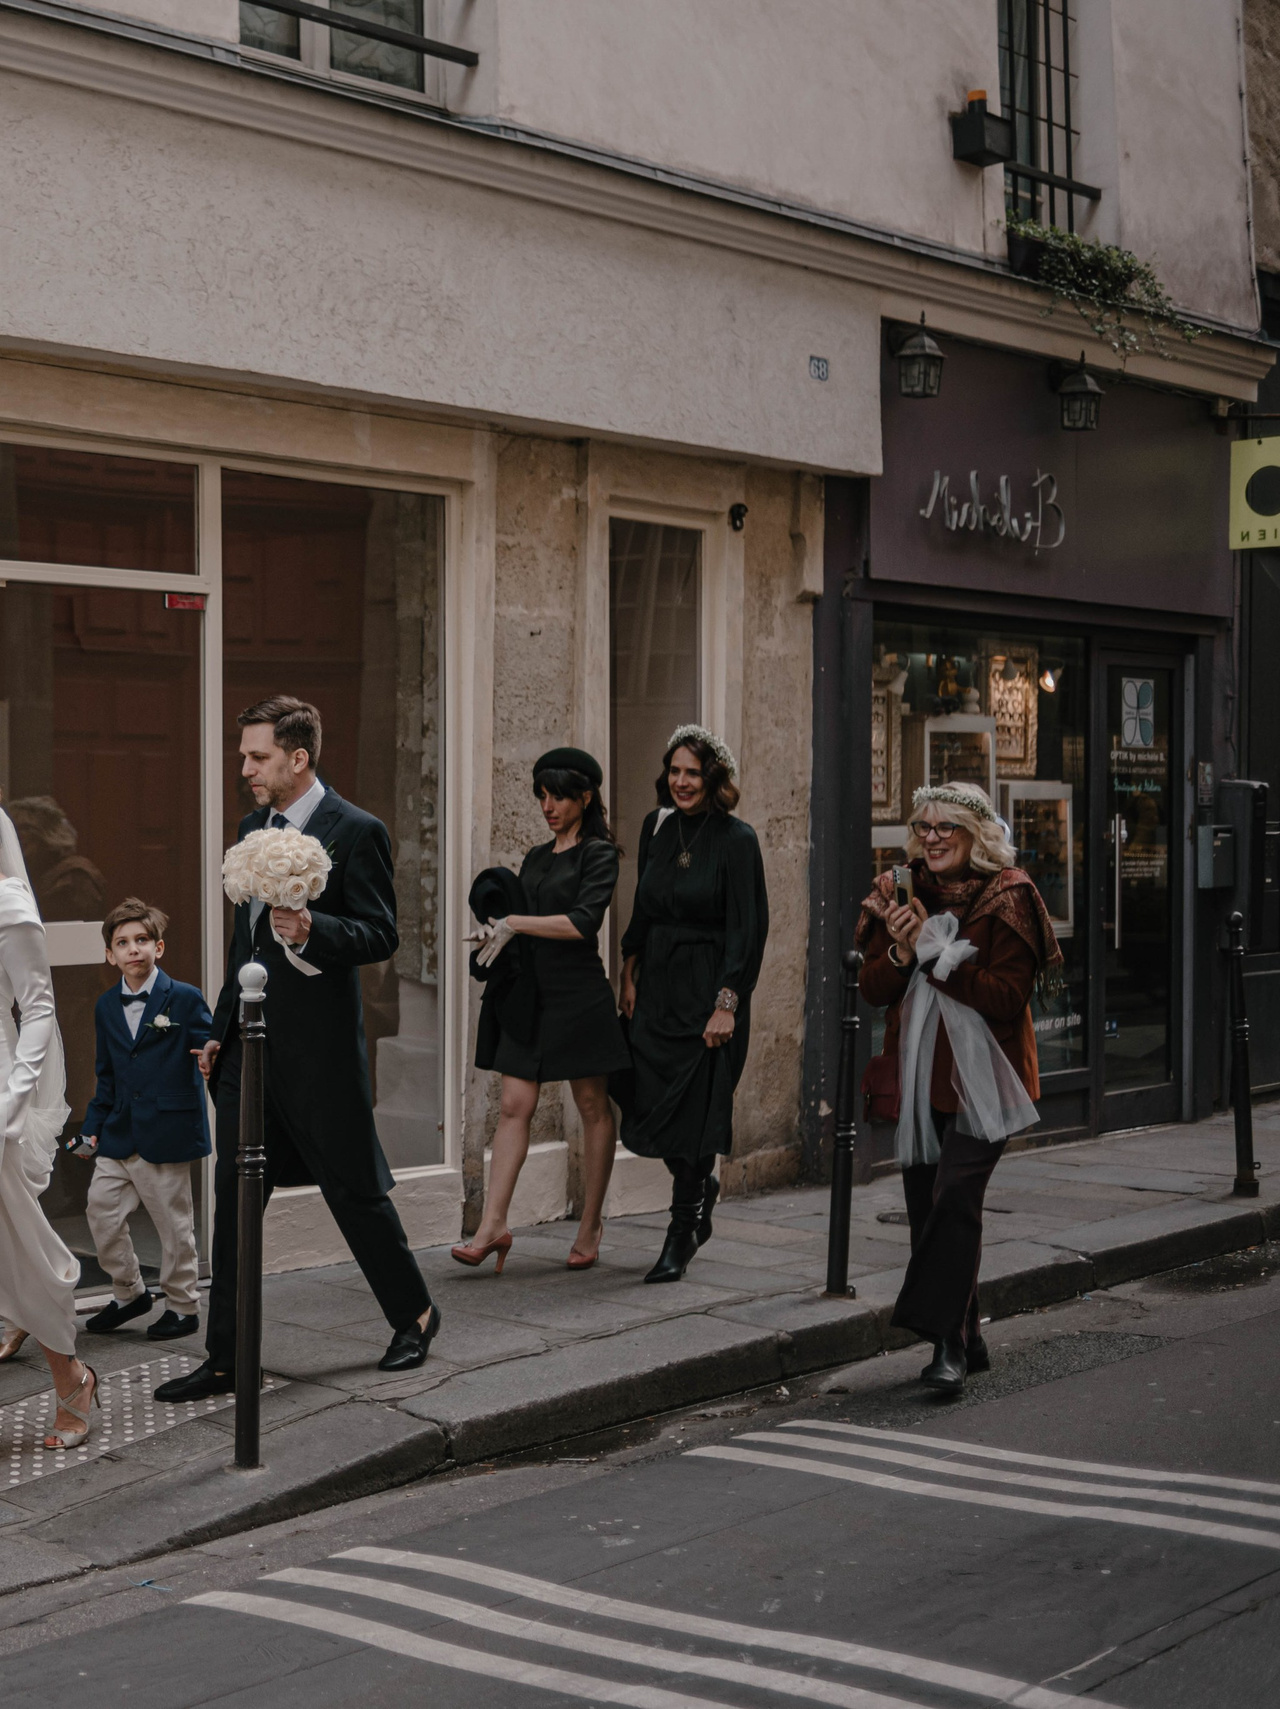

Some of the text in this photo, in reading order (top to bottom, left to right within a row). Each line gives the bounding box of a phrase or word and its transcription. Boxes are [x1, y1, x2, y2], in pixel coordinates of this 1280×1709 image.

[810, 358, 827, 379] 68
[1032, 467, 1066, 556] B
[1110, 750, 1128, 761] OPTIK
[1129, 751, 1136, 763] by
[1054, 1016, 1065, 1029] on
[1066, 1012, 1081, 1027] site
